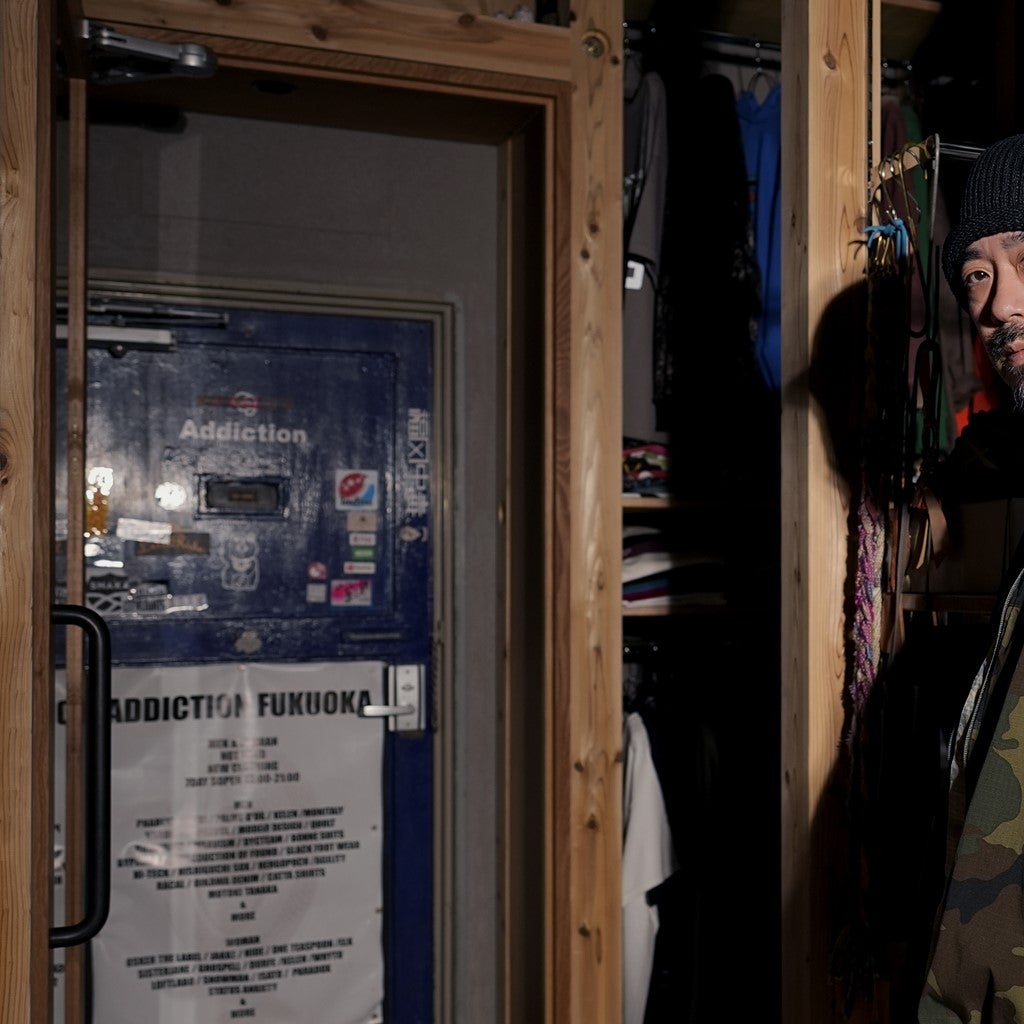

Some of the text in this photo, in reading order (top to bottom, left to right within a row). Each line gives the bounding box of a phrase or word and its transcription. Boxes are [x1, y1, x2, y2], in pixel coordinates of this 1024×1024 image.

[179, 418, 308, 446] Addiction
[111, 690, 371, 723] ADDICTION FUKUOKA
